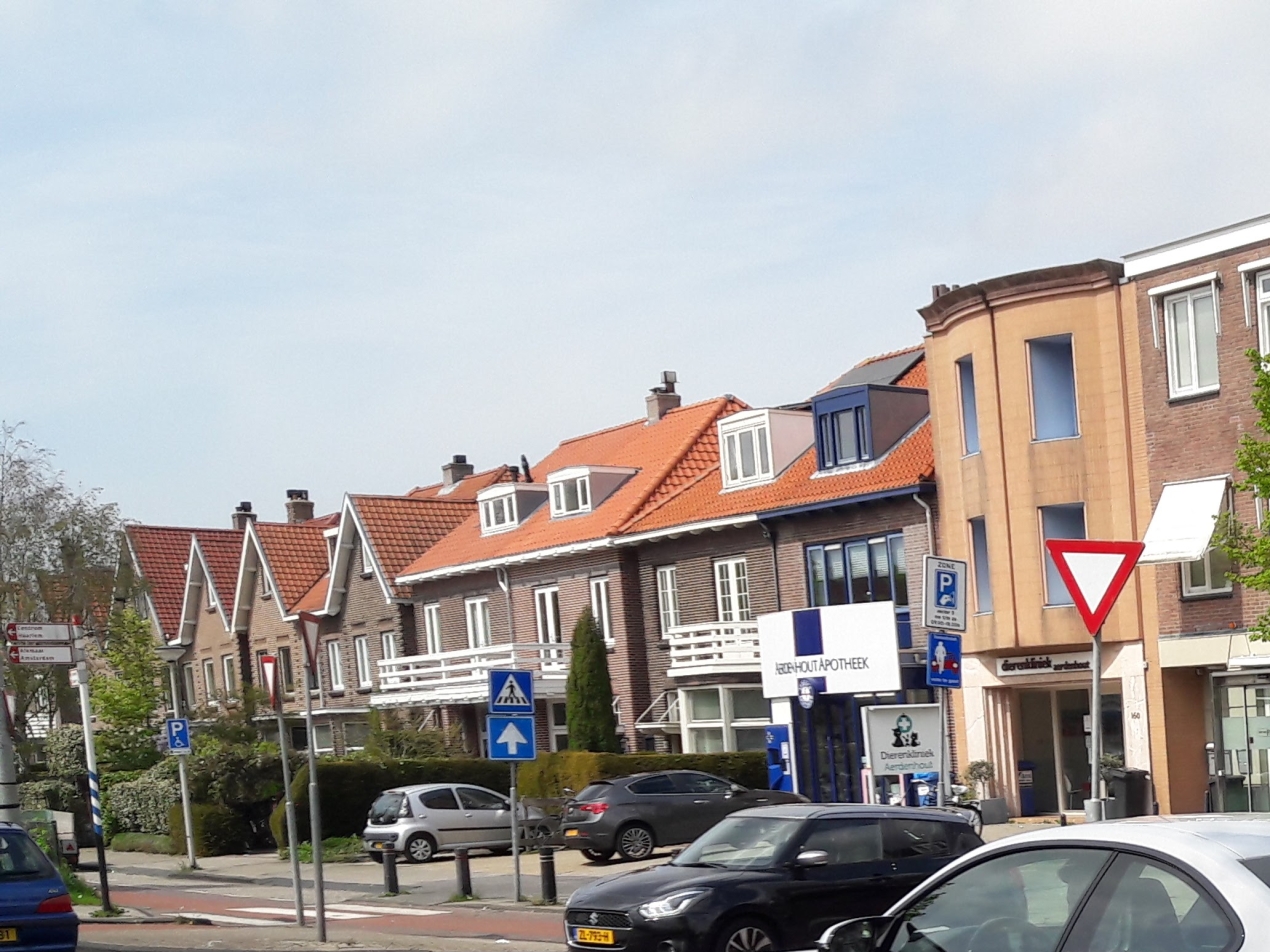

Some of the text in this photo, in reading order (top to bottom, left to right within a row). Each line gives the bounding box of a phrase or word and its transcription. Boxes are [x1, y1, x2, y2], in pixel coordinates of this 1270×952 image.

[938, 562, 955, 570] ZONE
[940, 573, 953, 592] P
[819, 657, 869, 672] APOTHEEK
[171, 721, 184, 737] P
[880, 749, 934, 760] Dierenkliniek
[884, 761, 933, 771] Aerdenhout
